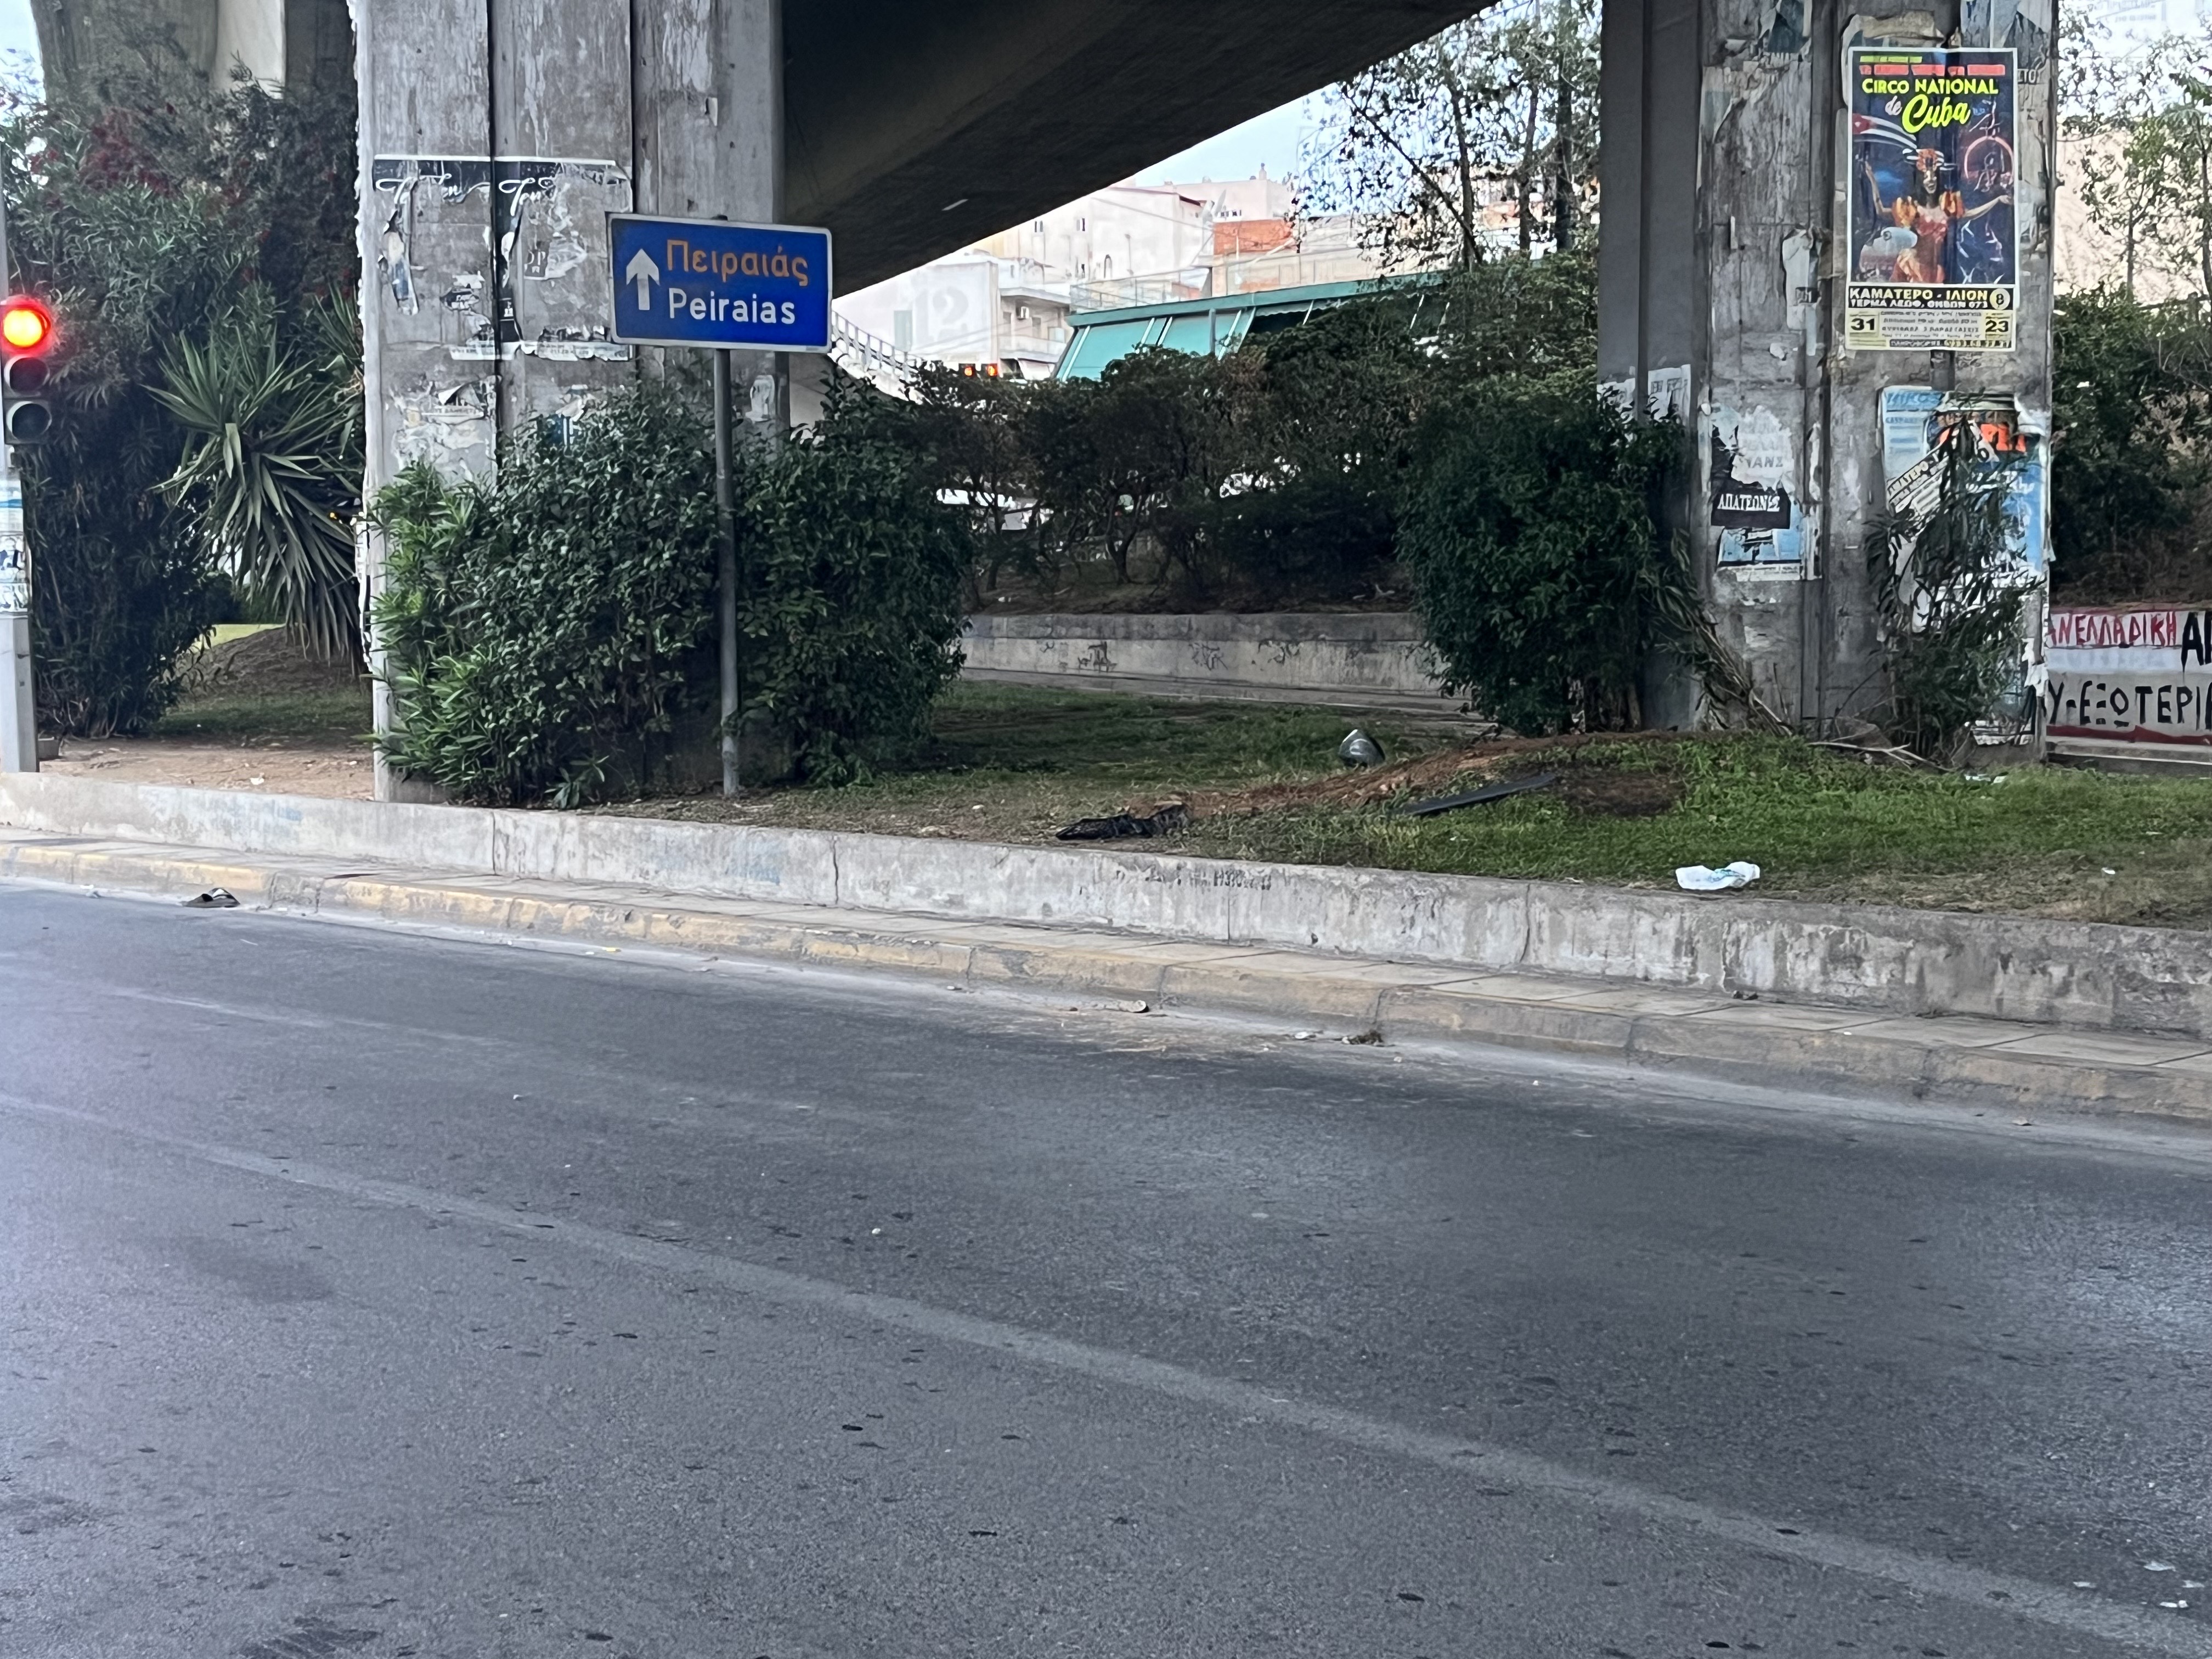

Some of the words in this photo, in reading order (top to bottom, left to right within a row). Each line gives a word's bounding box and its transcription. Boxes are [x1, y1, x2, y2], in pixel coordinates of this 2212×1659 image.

[1862, 78, 1909, 93] CIRCO
[1915, 78, 1999, 94] NATIONAL
[1884, 95, 1903, 116] de
[1902, 94, 1971, 133] Cuba
[667, 239, 809, 287] Πειραιάς
[1849, 287, 1933, 300] ΚΑΜΑΤΕΡΟ
[1946, 290, 1988, 301] ΙΛΙΟΝ
[668, 287, 795, 324] Peiraias
[1850, 318, 1875, 331] 31
[1985, 319, 2009, 332] 23
